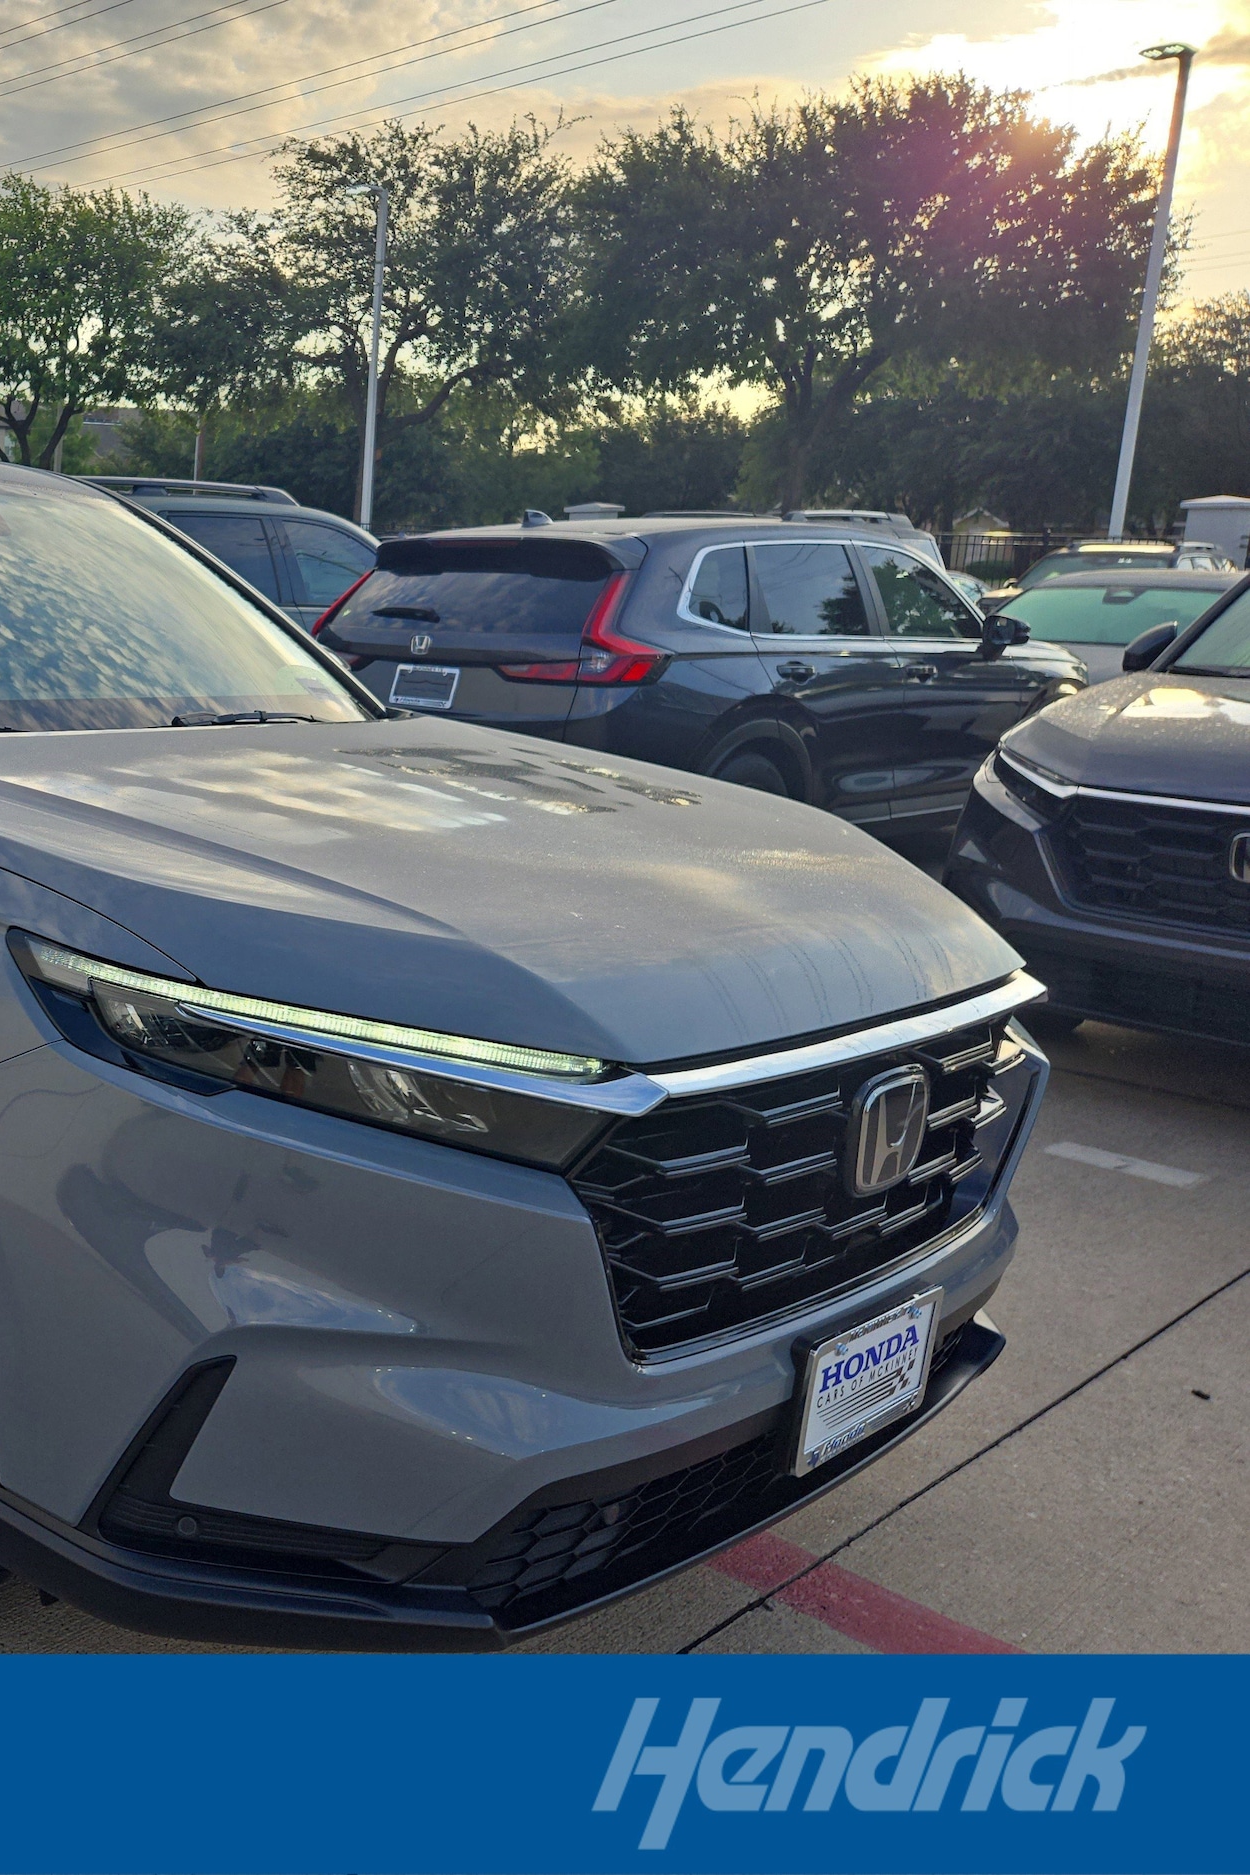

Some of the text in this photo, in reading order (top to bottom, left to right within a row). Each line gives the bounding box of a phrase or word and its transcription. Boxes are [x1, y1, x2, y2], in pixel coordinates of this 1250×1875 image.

[816, 1347, 919, 1409] CARS OF MCKINNEY
[819, 1324, 919, 1393] HONDA
